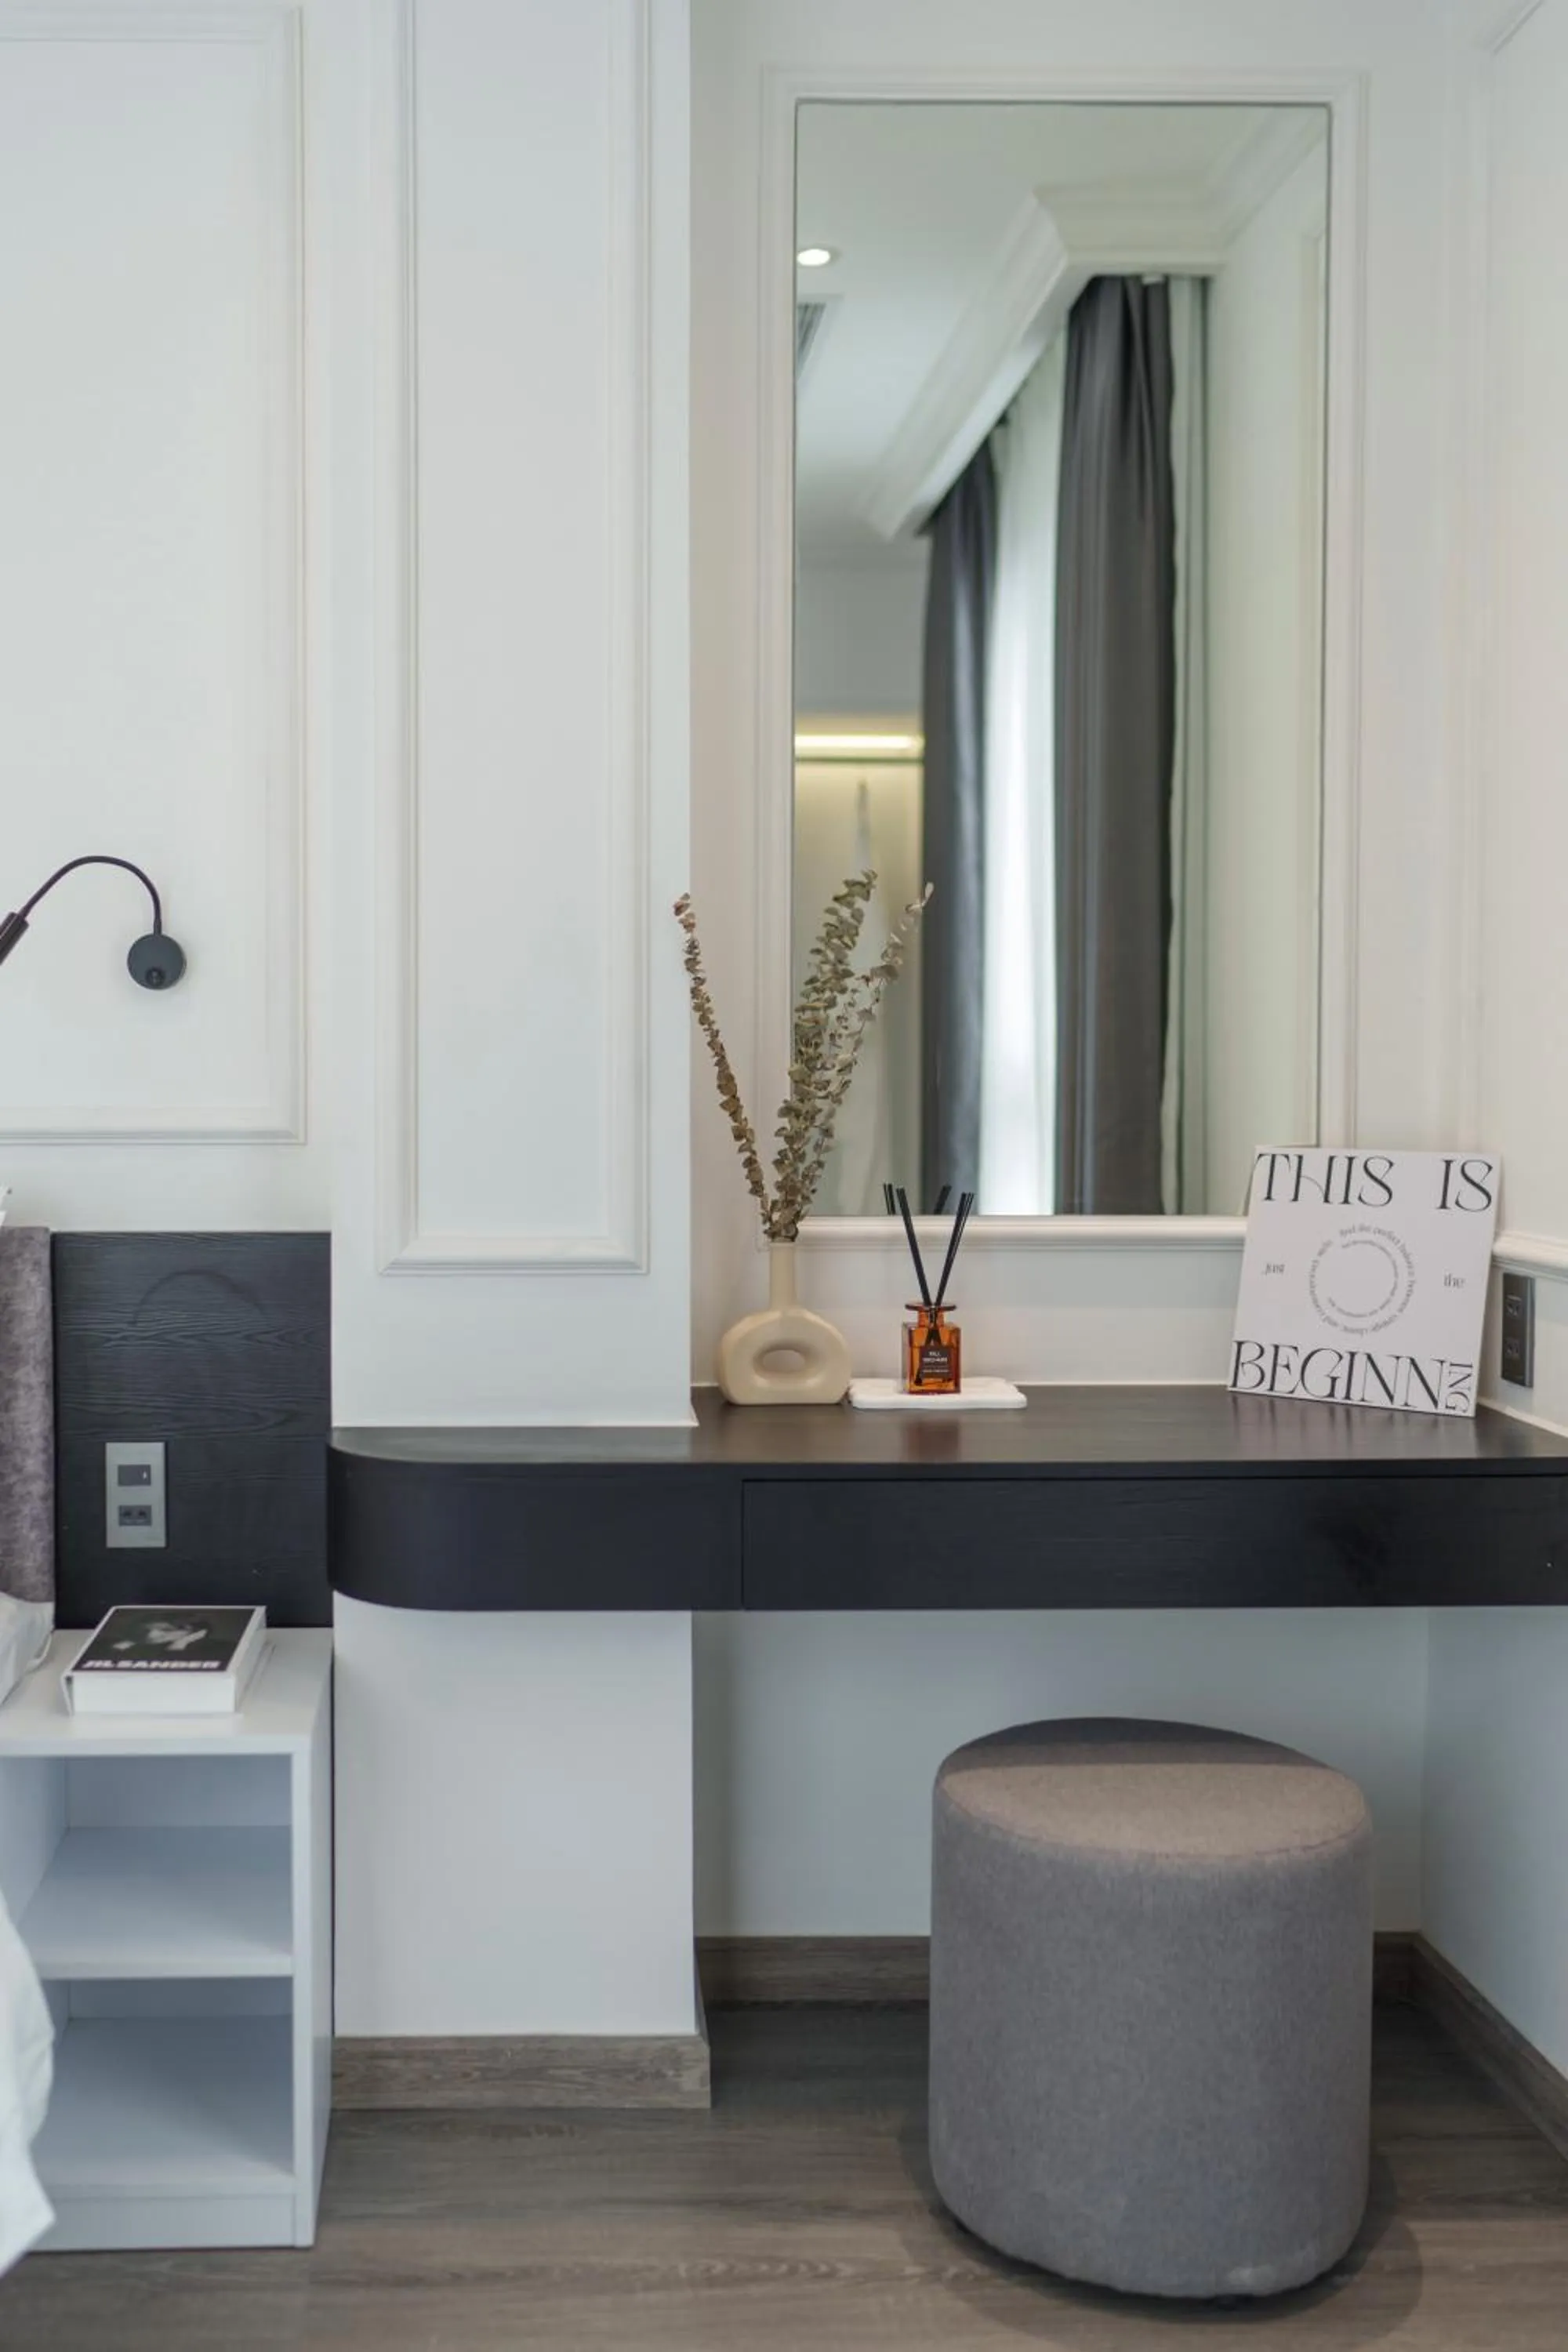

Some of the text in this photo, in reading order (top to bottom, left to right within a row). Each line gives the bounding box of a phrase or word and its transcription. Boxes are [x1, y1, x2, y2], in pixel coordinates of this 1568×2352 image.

[1254, 1152, 1494, 1213] THIS IS
[1443, 1272, 1465, 1289] the
